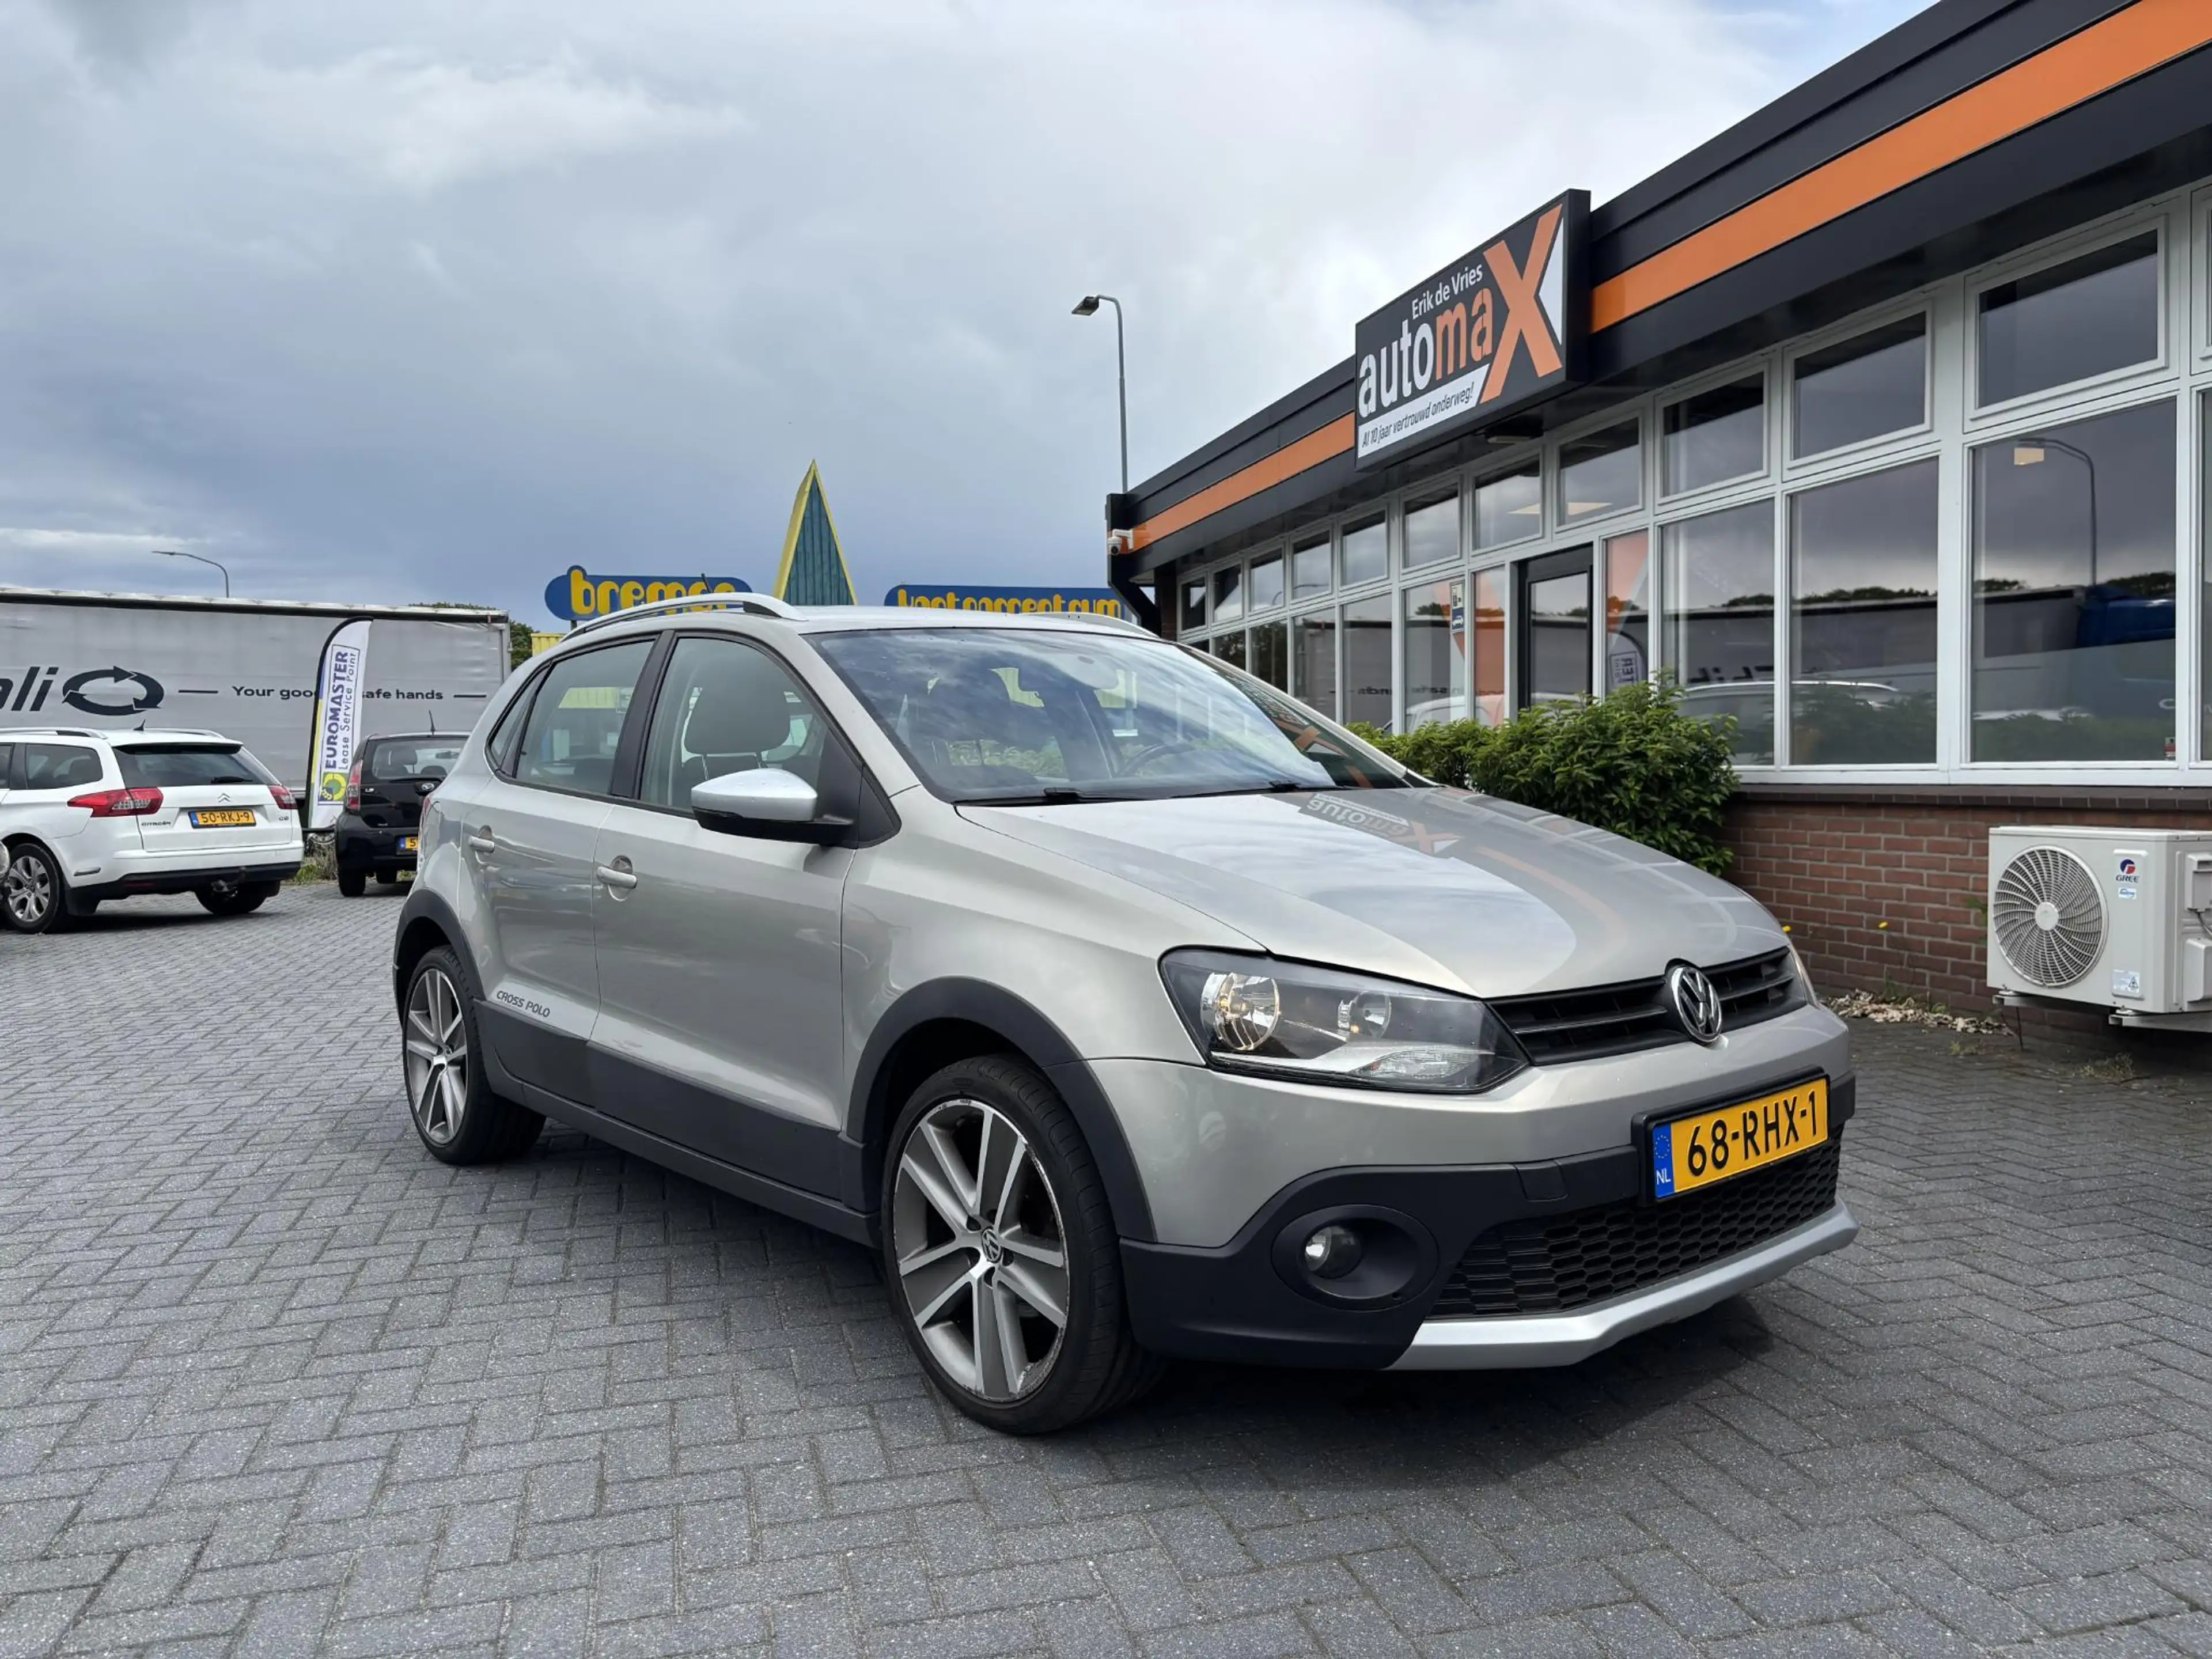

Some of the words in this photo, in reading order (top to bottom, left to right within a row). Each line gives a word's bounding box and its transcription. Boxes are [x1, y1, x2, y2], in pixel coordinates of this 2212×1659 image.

[1412, 290, 1434, 320] Erik
[1435, 282, 1450, 306] de
[1451, 263, 1483, 295] Vries
[1377, 425, 1393, 444] jaar
[1392, 405, 1431, 433] vertrouwd
[1431, 381, 1475, 415] onderweg!
[346, 652, 357, 682] Point
[232, 685, 274, 698] Your
[396, 688, 443, 699] hands
[340, 687, 353, 732] Service
[325, 650, 349, 770] EUROMASTER
[339, 735, 349, 770] Lease
[201, 810, 250, 824] 50-RKJ-9
[2115, 874, 2141, 884] GREE
[497, 990, 525, 1007] CROSS
[525, 1001, 551, 1018] POLO
[1656, 1168, 1671, 1185] NL
[1687, 1089, 1817, 1176] 68-RHX-1
